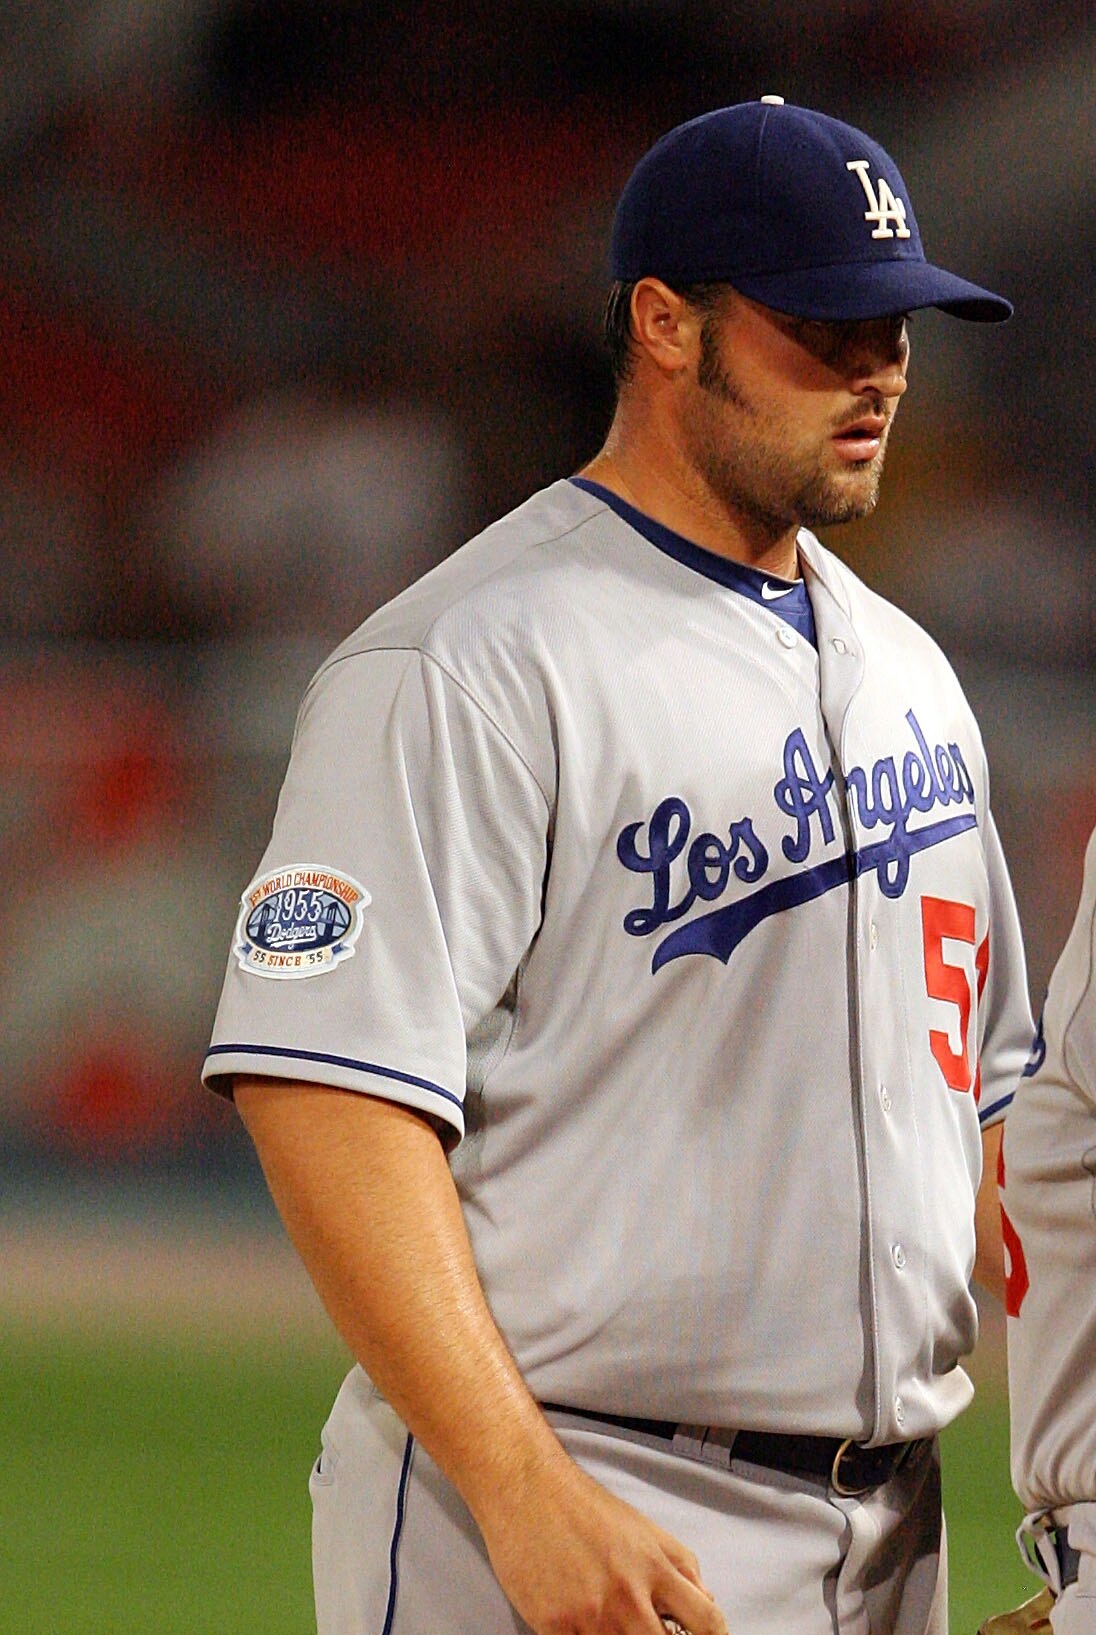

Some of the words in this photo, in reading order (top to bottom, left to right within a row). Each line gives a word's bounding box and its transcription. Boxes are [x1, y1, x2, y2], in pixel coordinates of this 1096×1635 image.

[846, 160, 911, 239] LA
[617, 797, 769, 936] Los
[774, 708, 976, 899] Angeles
[262, 874, 292, 897] WORLD
[294, 871, 360, 904] CHAMPIONSHIP
[273, 889, 324, 922] 1955
[265, 922, 317, 950] Dodgers
[253, 950, 266, 963] 55
[267, 956, 302, 967] SINCE
